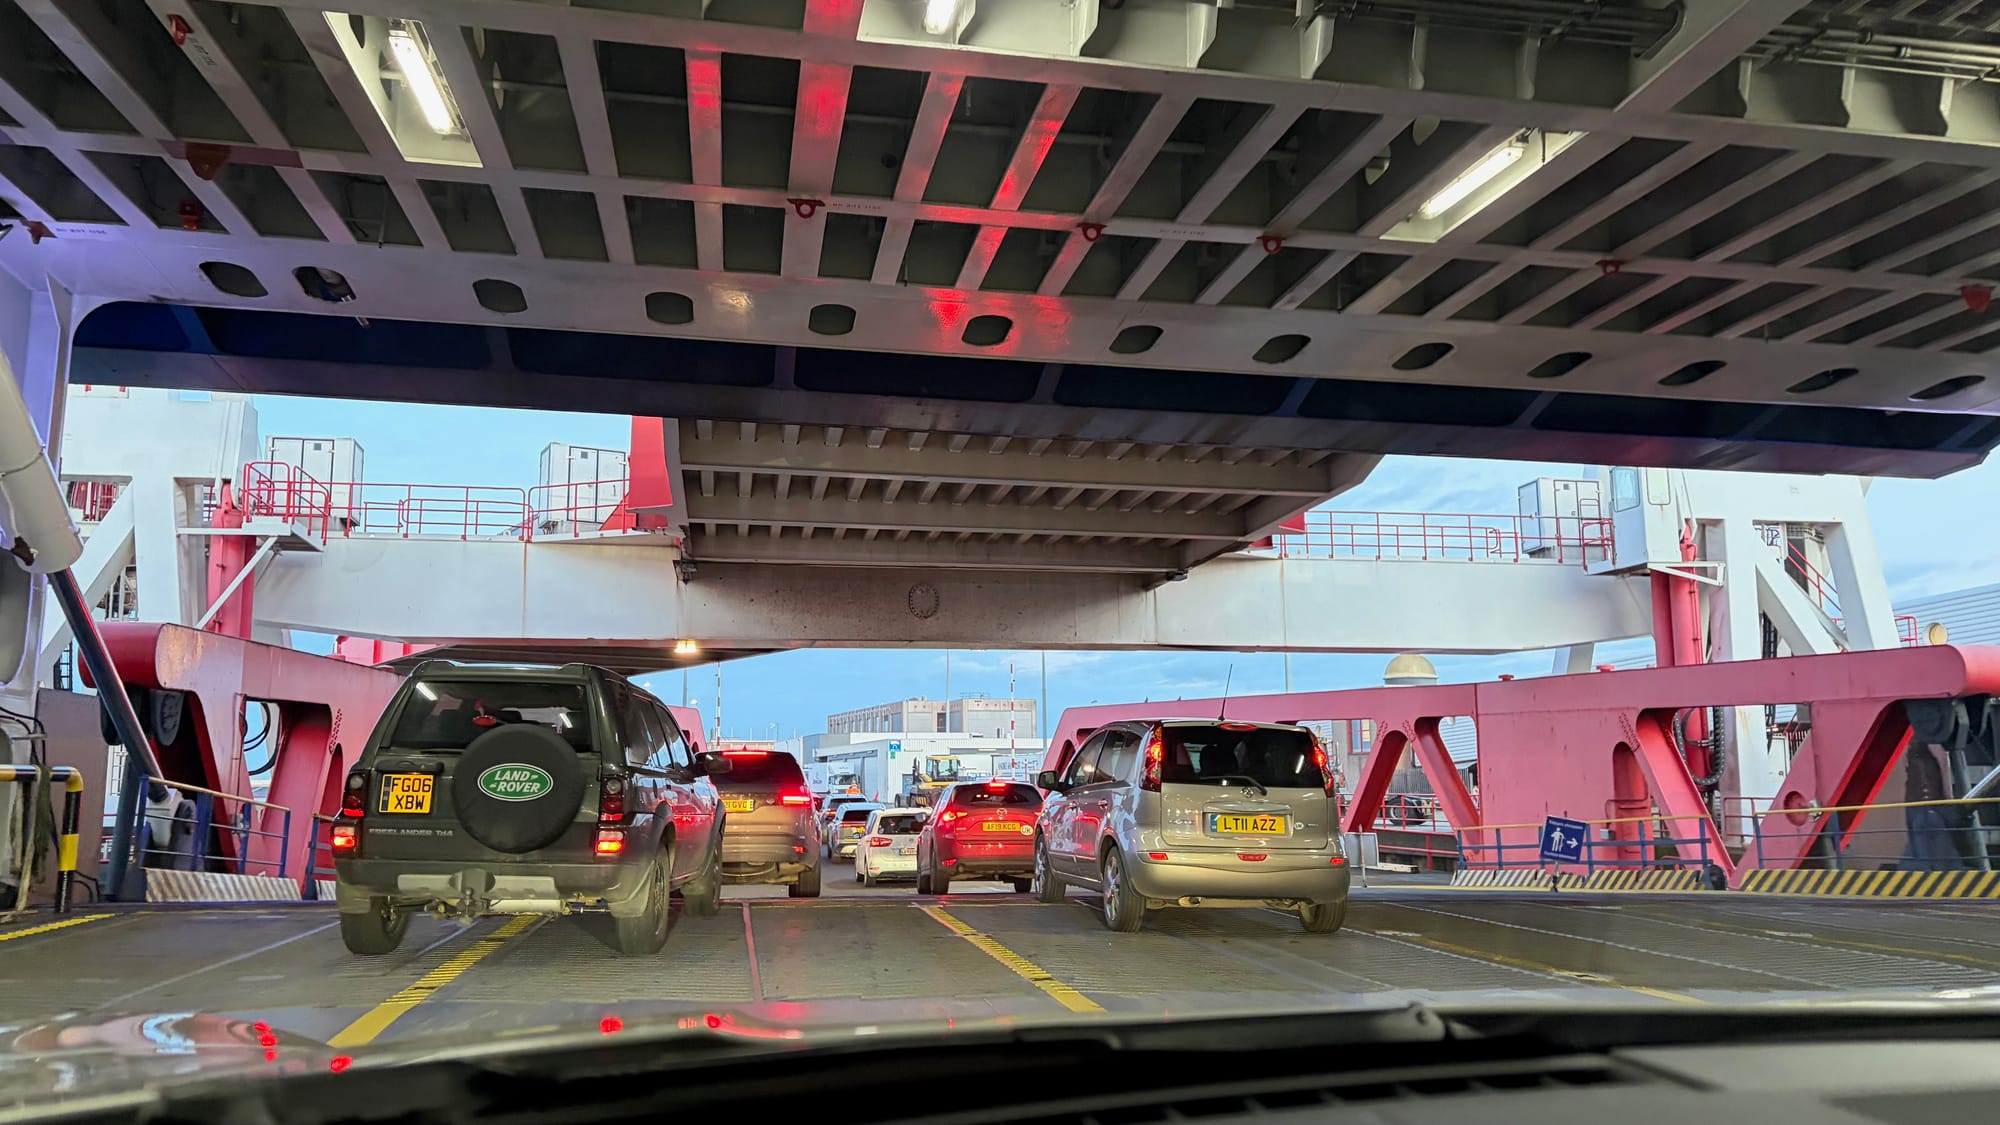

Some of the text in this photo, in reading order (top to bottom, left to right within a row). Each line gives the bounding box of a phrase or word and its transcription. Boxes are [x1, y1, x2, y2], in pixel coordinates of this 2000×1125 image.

[495, 770, 531, 781] LAND
[391, 778, 432, 792] FG06
[497, 781, 541, 792] ROVER
[394, 795, 425, 809] XBW
[1223, 818, 1277, 831] LT11 AZZ
